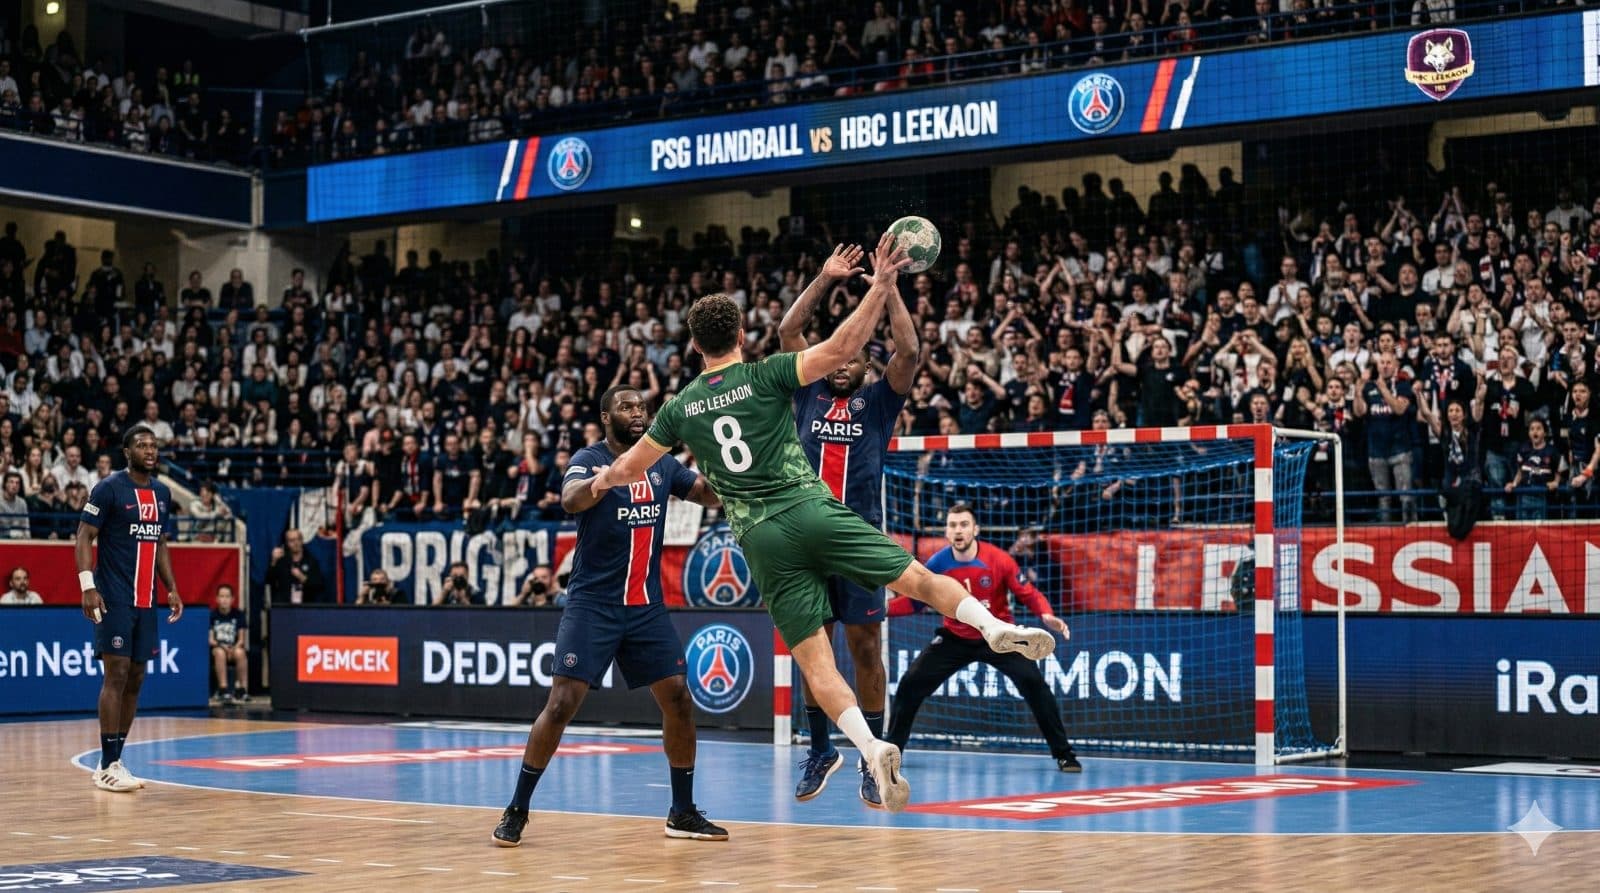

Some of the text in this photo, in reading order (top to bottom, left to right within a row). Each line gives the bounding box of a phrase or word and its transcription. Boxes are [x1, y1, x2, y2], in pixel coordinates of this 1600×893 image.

[650, 100, 998, 171] PSG HANDBALL VS HBC LEEKAON
[684, 383, 753, 418] HBC LEEKAON
[811, 420, 863, 437] PARIS
[712, 415, 753, 473] 8
[632, 480, 647, 500] 27
[141, 503, 155, 520] 27
[617, 503, 661, 521] PARIS
[129, 523, 162, 536] PARIS
[701, 533, 743, 557] PAR
[696, 629, 741, 652] PARIS
[36, 639, 180, 677] Netk
[306, 644, 390, 674] PEMCEK
